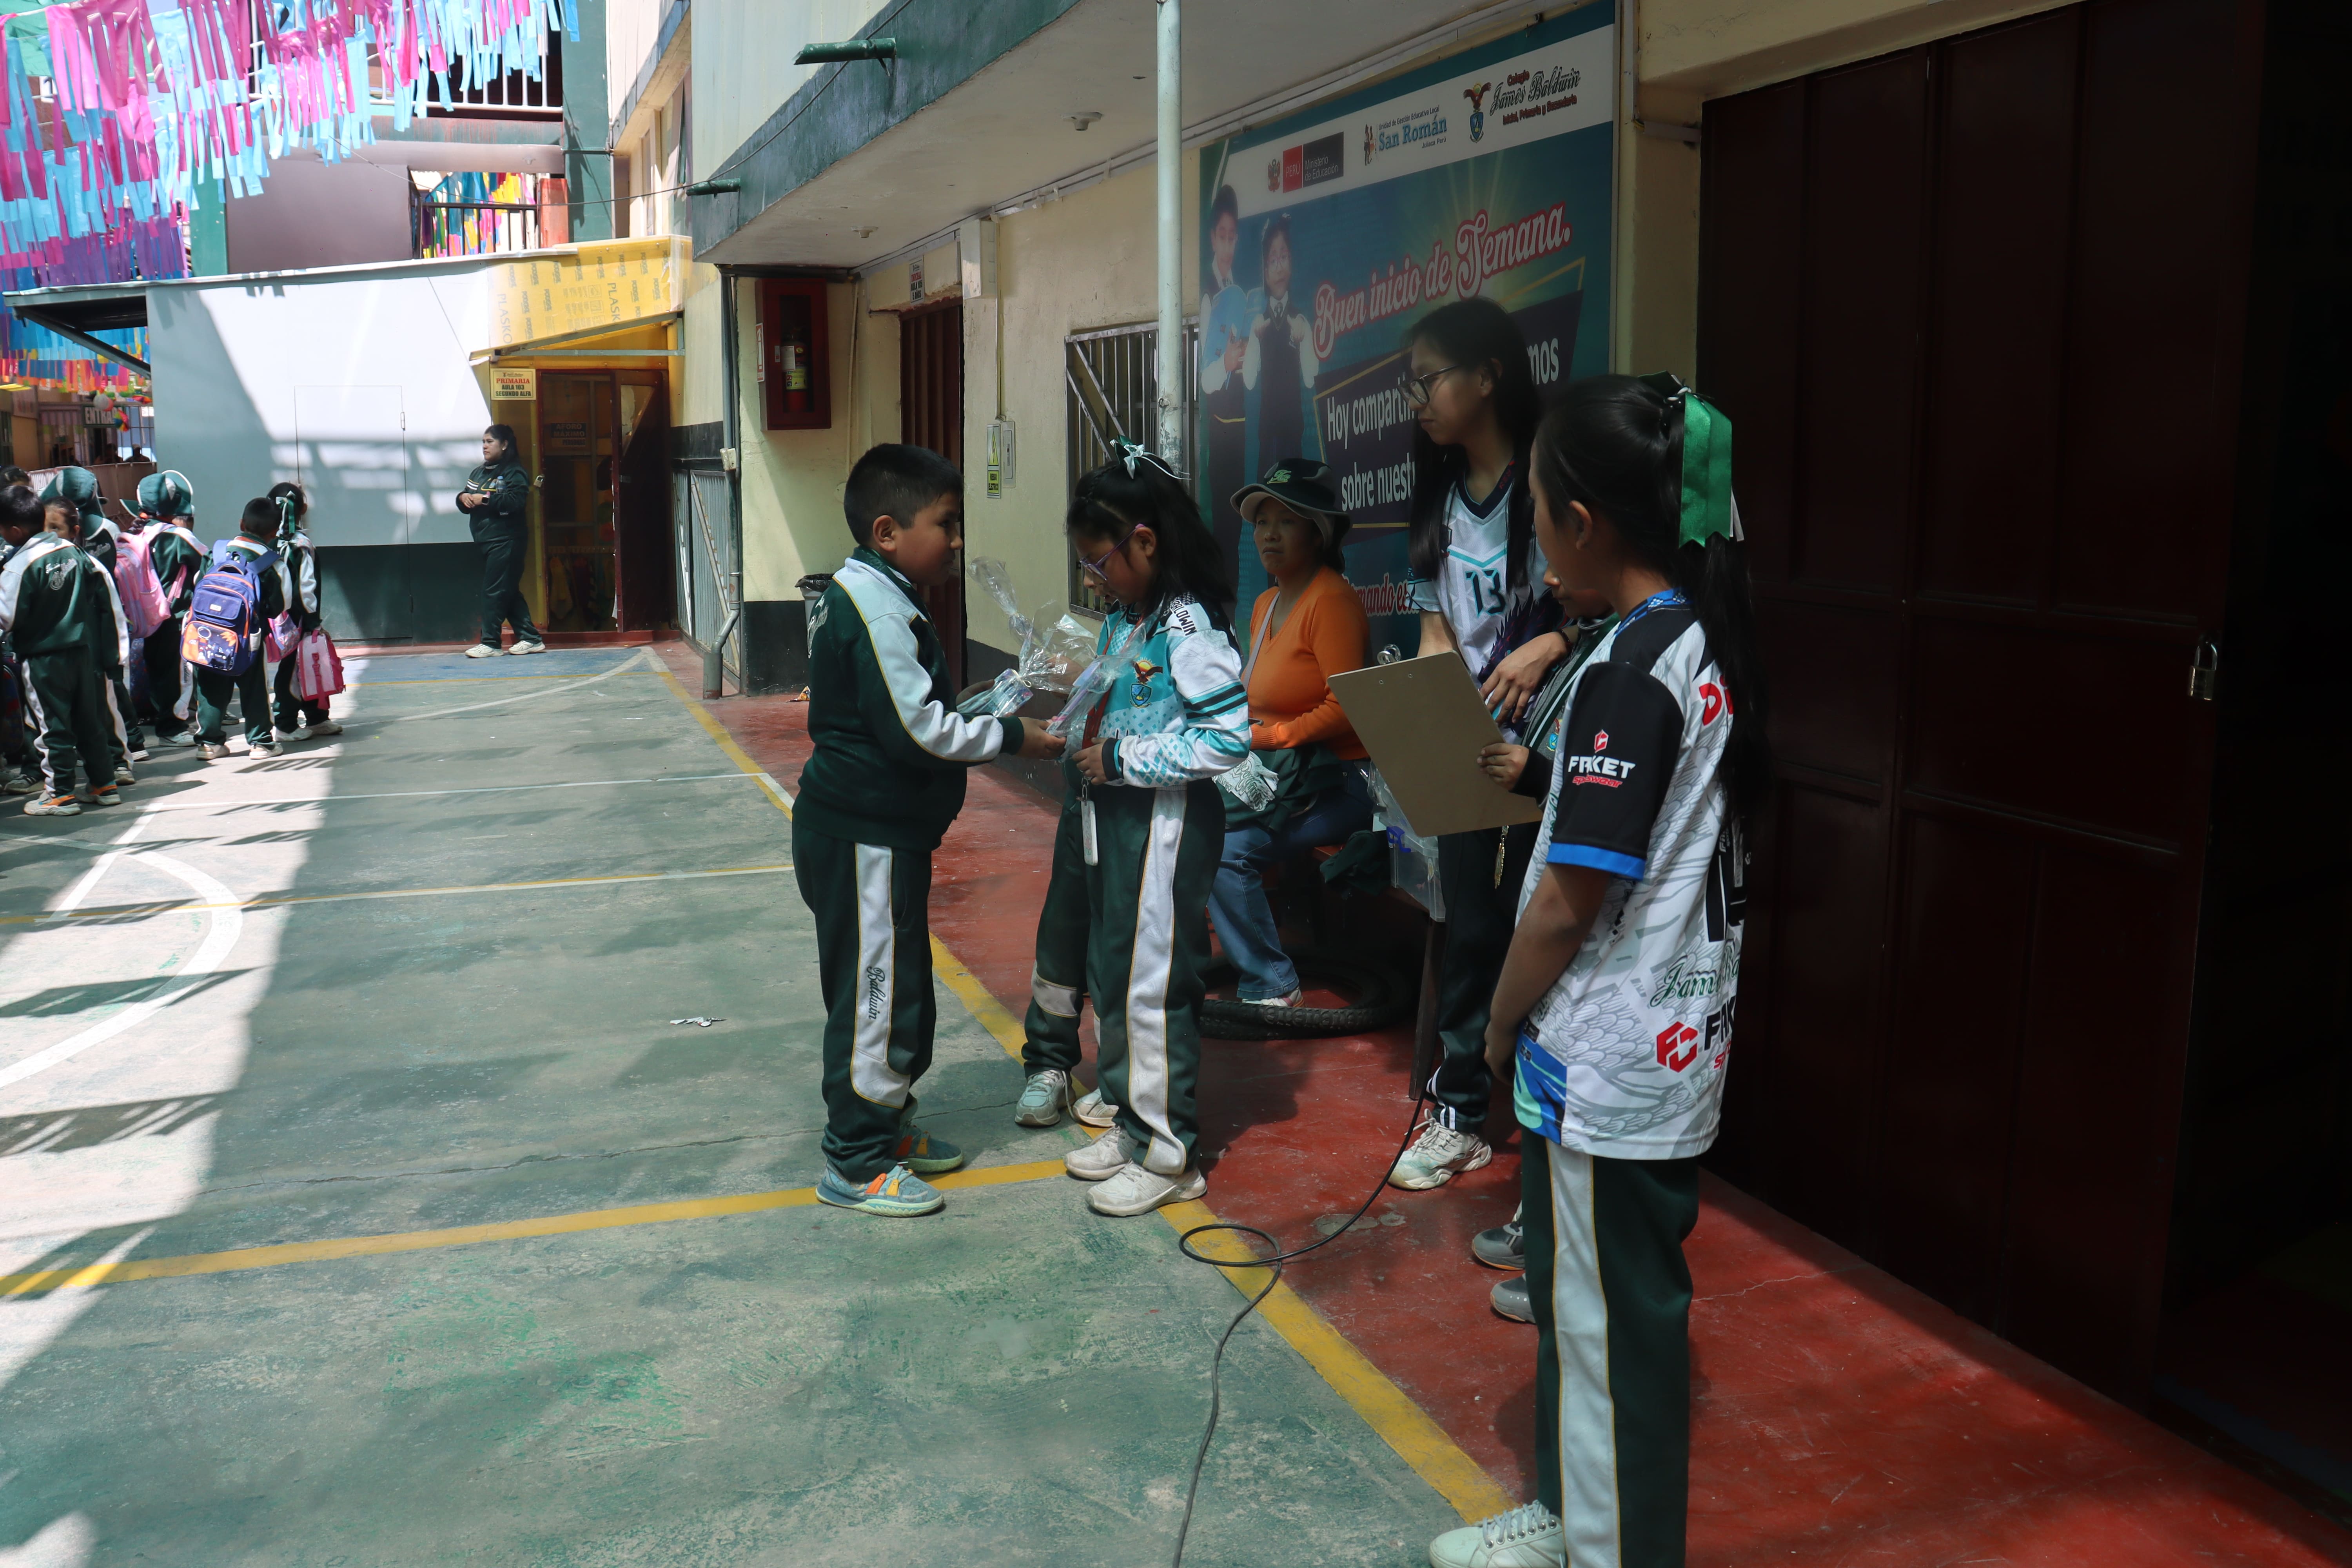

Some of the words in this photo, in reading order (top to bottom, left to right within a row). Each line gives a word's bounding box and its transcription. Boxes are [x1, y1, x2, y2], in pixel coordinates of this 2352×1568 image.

[1490, 82, 1526, 116] James
[1528, 66, 1581, 102] Baldwin
[1379, 120, 1391, 130] Unidad
[1397, 115, 1410, 124] Gestión
[1411, 109, 1429, 120] Educativa
[1430, 105, 1440, 114] Local
[1379, 132, 1399, 151] San
[1403, 114, 1447, 144] Román
[1286, 161, 1300, 178] PERÚ
[1305, 154, 1328, 169] Ministerio
[1305, 172, 1311, 181] de
[1312, 163, 1338, 179] Educación
[607, 283, 621, 322] PLASK
[1314, 282, 1367, 359] Buen
[1369, 256, 1422, 321] inicio
[1425, 243, 1451, 299] de
[1327, 396, 1349, 450] Hoy
[1341, 461, 1374, 512] sobre
[1466, 568, 1506, 617] 13
[1171, 601, 1198, 636] BALDWIN
[867, 966, 886, 1020] Baldwin
